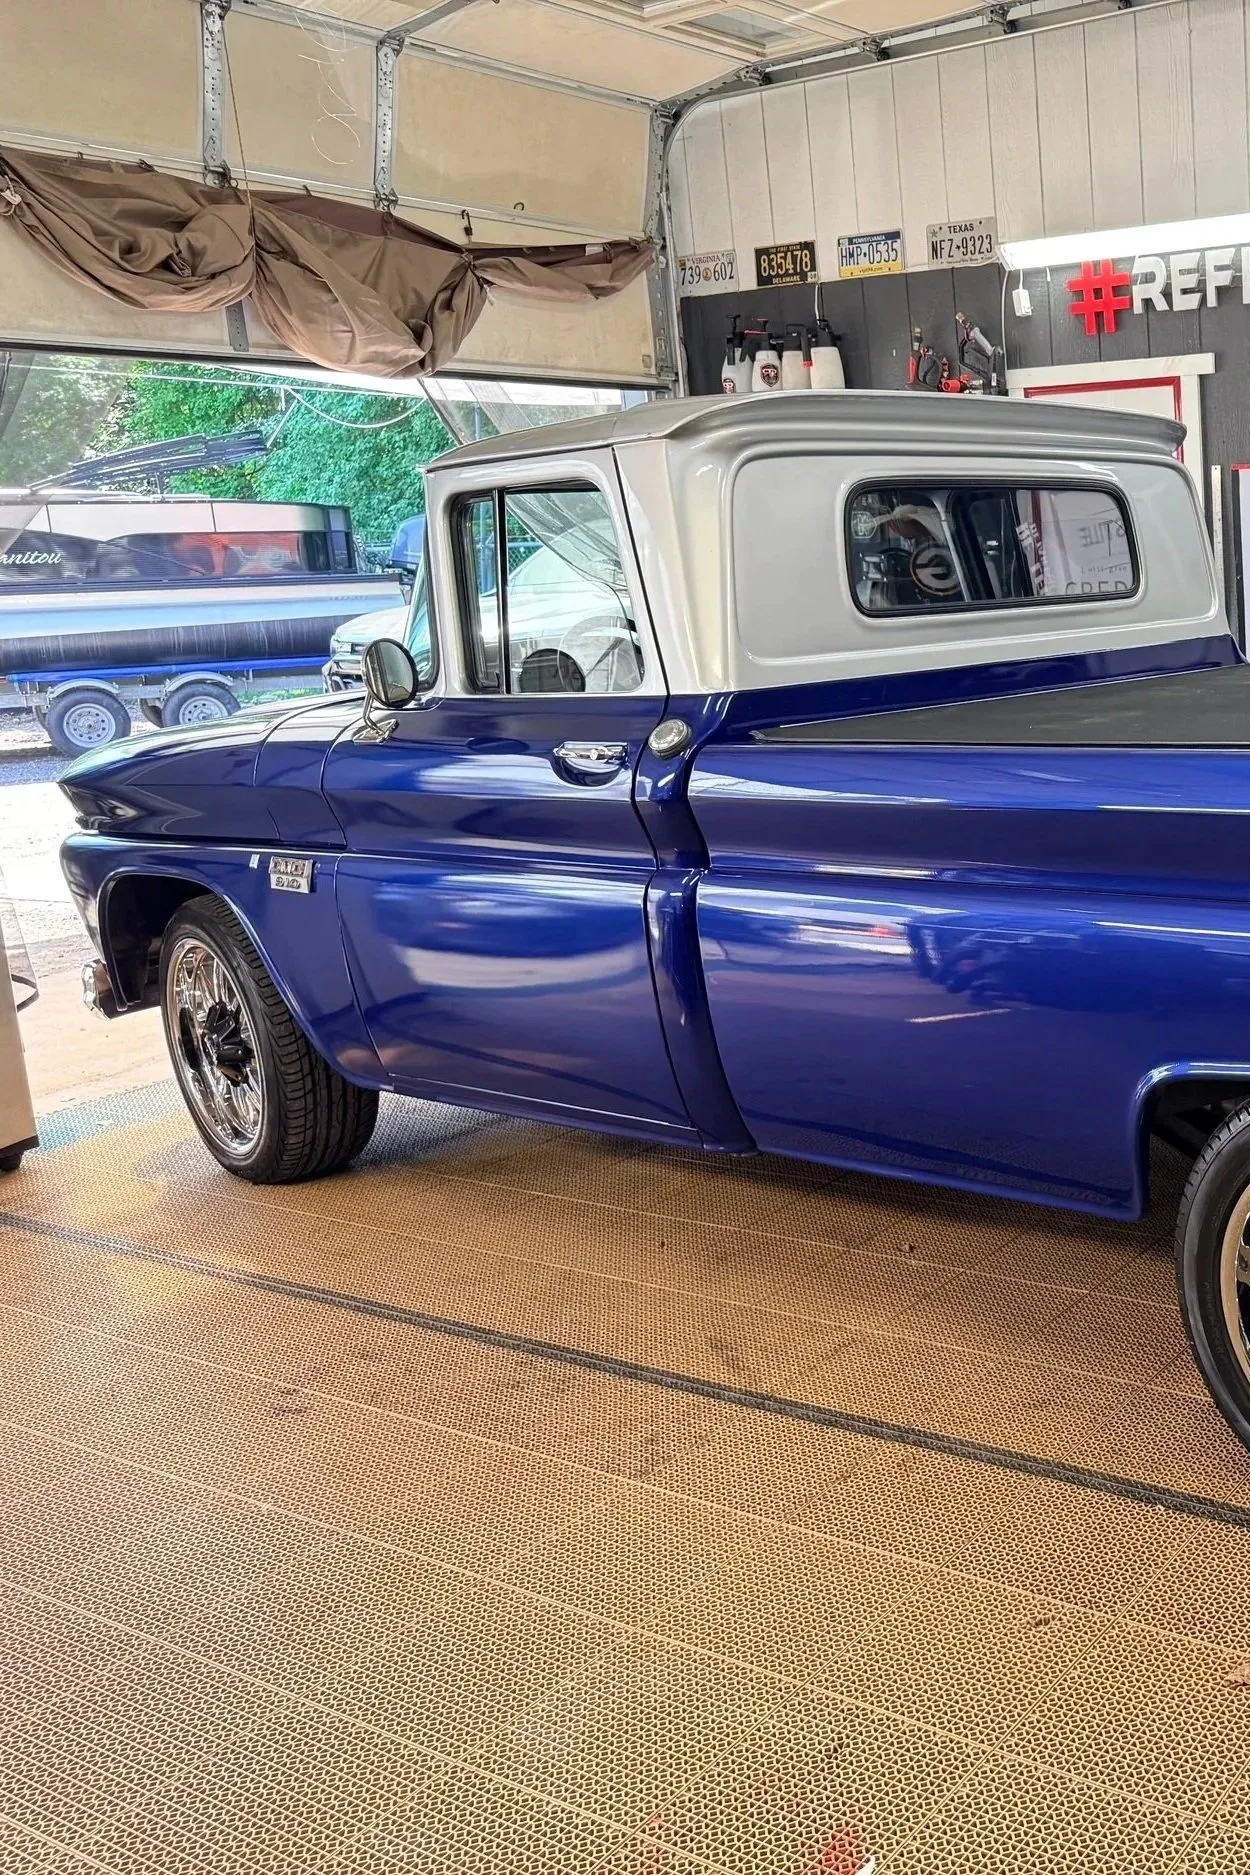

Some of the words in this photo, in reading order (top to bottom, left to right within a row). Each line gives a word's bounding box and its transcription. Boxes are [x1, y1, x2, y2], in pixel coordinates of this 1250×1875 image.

[947, 223, 975, 235] TEXAS
[840, 246, 863, 267] HMP
[868, 240, 898, 265] 0535
[931, 239, 954, 260] NFZ
[961, 233, 993, 256] 9323
[691, 254, 721, 265] VIRGINIA
[760, 249, 811, 277] 835478
[680, 265, 702, 286] 739
[713, 262, 734, 282] 602
[772, 275, 801, 284] DELAWARE
[0, 551, 62, 565] anitou
